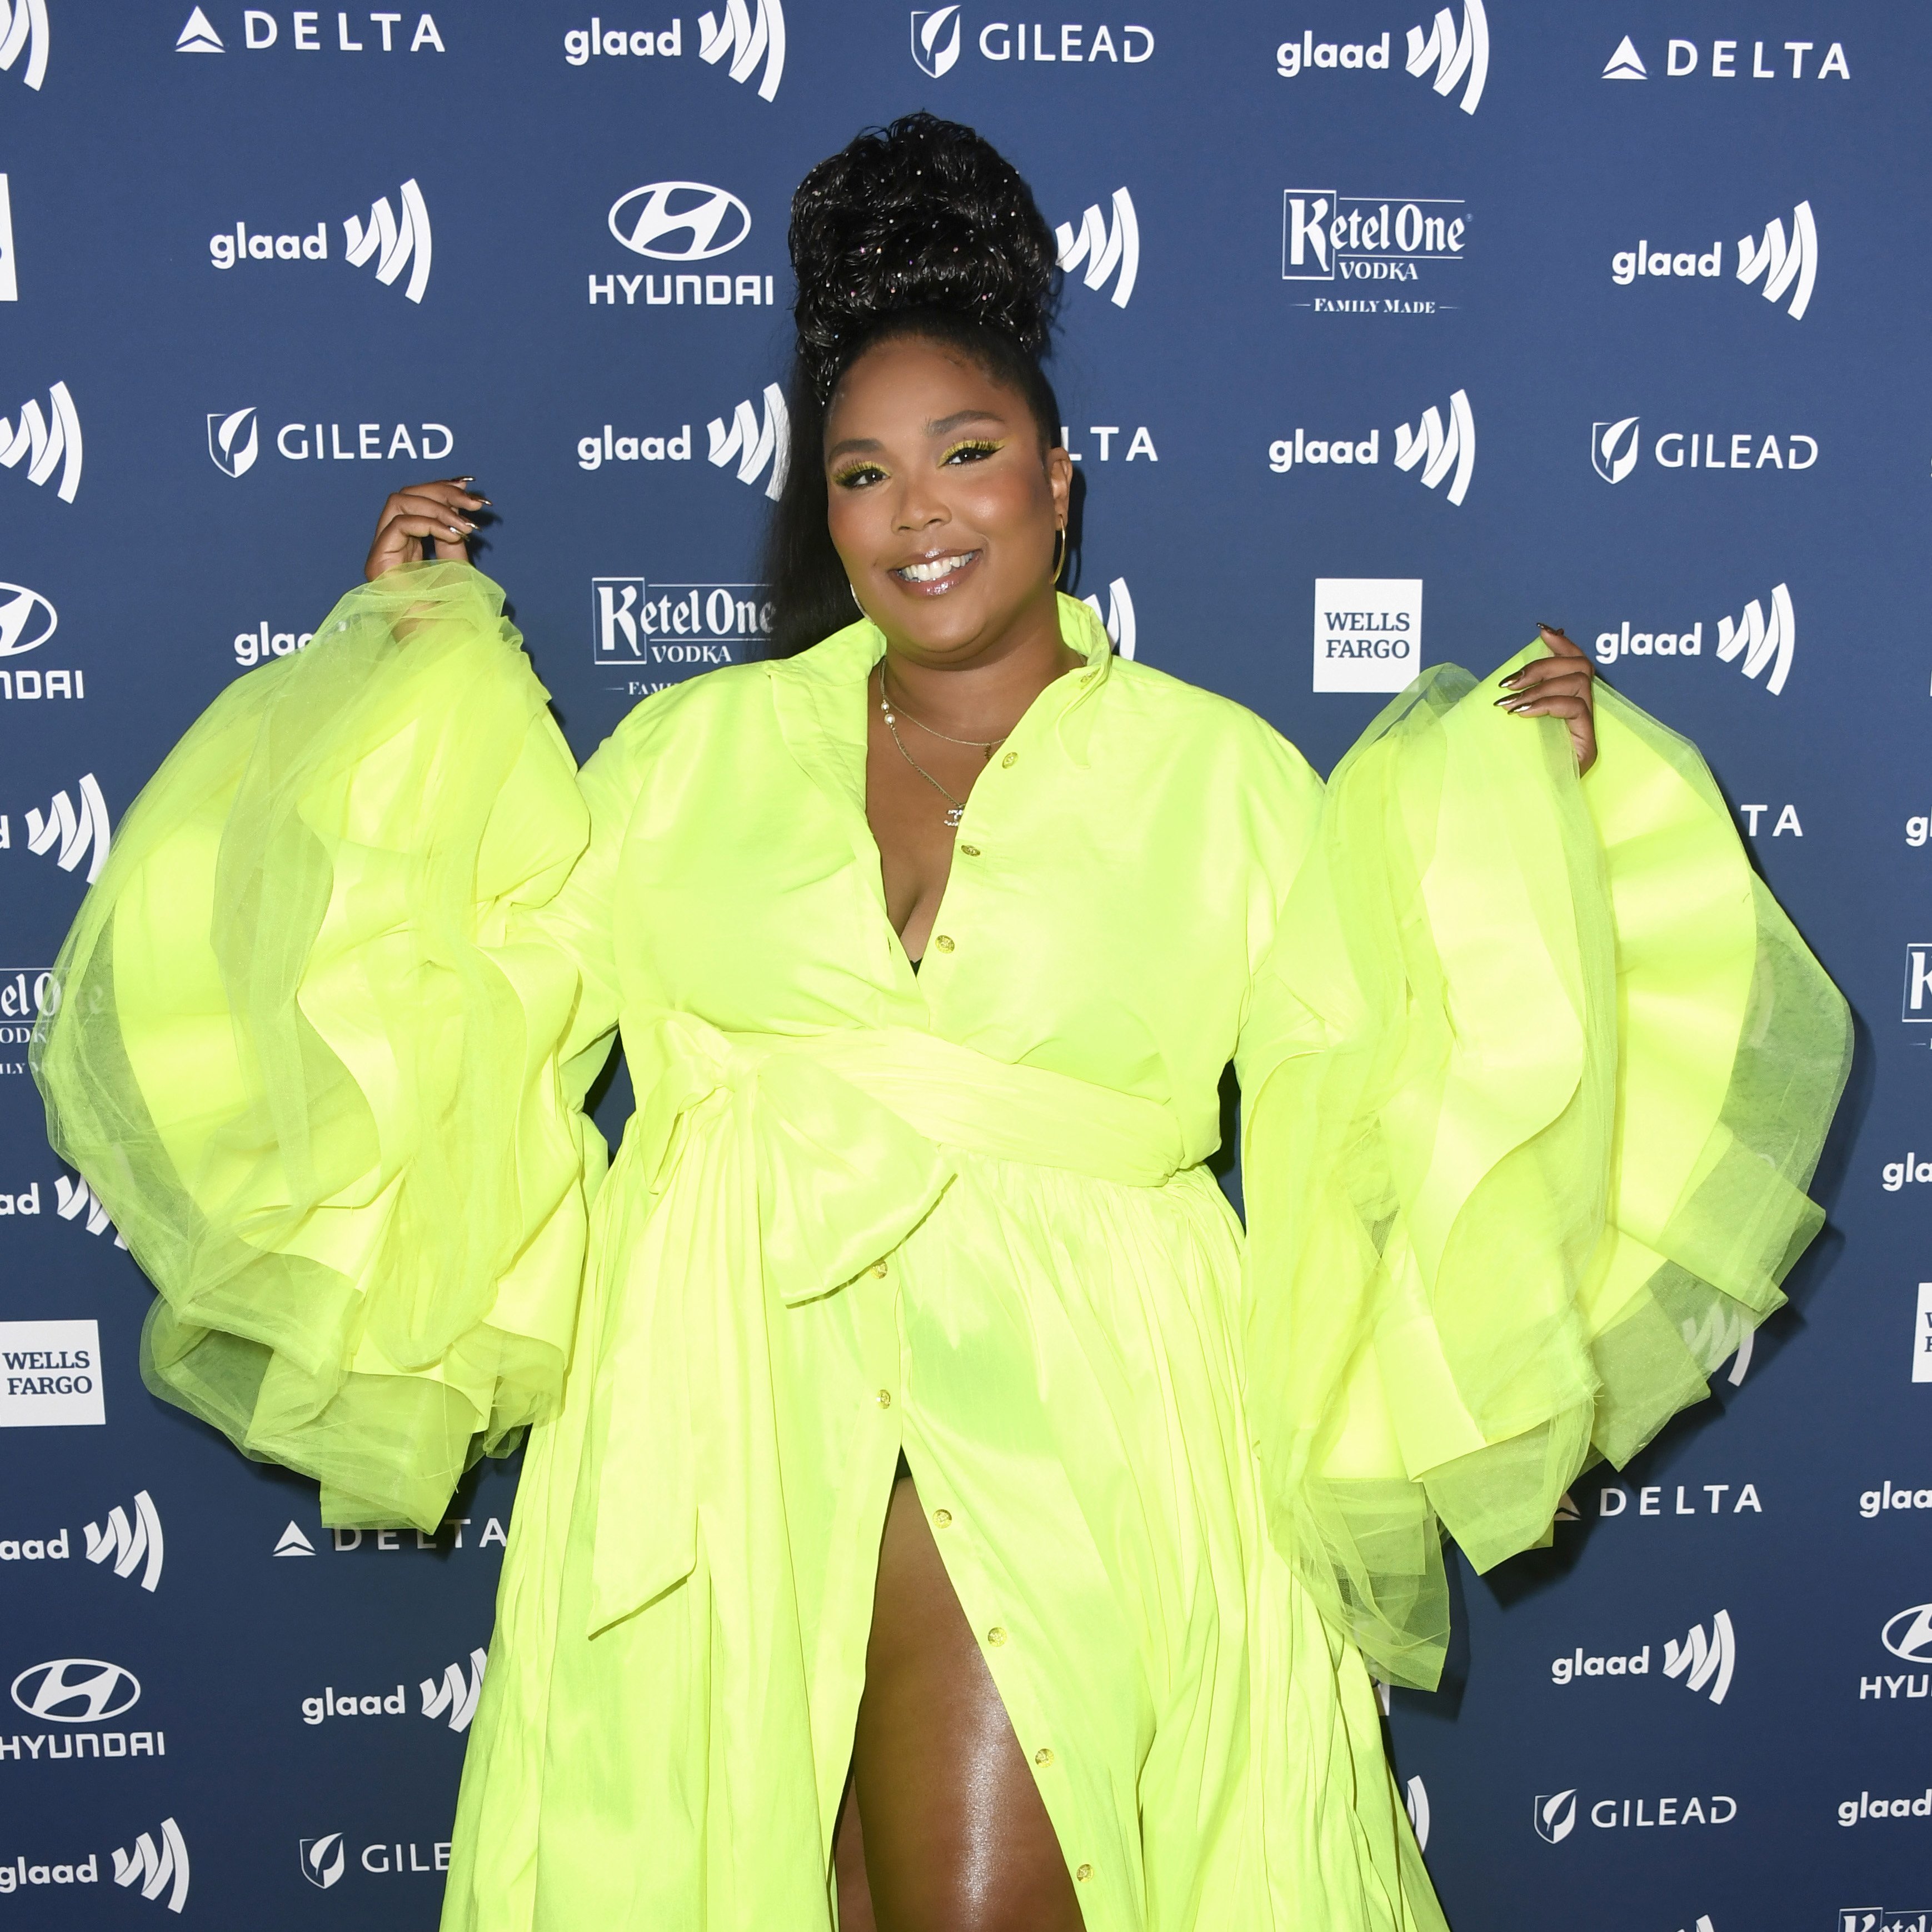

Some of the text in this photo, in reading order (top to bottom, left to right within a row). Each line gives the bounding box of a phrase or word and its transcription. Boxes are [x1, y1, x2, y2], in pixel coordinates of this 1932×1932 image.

[244, 11, 445, 52] DELTA
[565, 18, 681, 66] glaad
[979, 23, 1155, 63] GILEAD
[1277, 31, 1390, 77] glaad
[1667, 39, 1850, 79] DELTA
[209, 222, 327, 269] glaad
[1289, 198, 1465, 272] Ketel One
[1339, 261, 1419, 281] VODKA
[1612, 240, 1722, 285] glaad
[589, 274, 773, 305] HYUNDAI
[1314, 298, 1435, 313] FAMILY MADE
[277, 423, 453, 460] GILEAD
[578, 425, 691, 470] glaad
[1269, 428, 1379, 473] glaad
[1655, 433, 1818, 470] GILEAD
[597, 585, 776, 656] Ketel One
[1324, 612, 1410, 632] WELLS
[651, 645, 732, 664] VODKA
[1326, 640, 1410, 659] FARGO
[1595, 621, 1703, 665] glaad
[2, 1350, 91, 1370] WELLS
[7, 1375, 93, 1395] FARGO
[1600, 1484, 1763, 1517] DELTA
[1551, 1645, 1650, 1685] glaad
[302, 1685, 406, 1725] glaad
[0, 1731, 166, 1760] HYUNDAI
[1591, 1796, 1737, 1828] GILEAD
[1838, 1789, 1932, 1827] glaad
[0, 1854, 98, 1893] glaad
[361, 1842, 452, 1873] GILE
